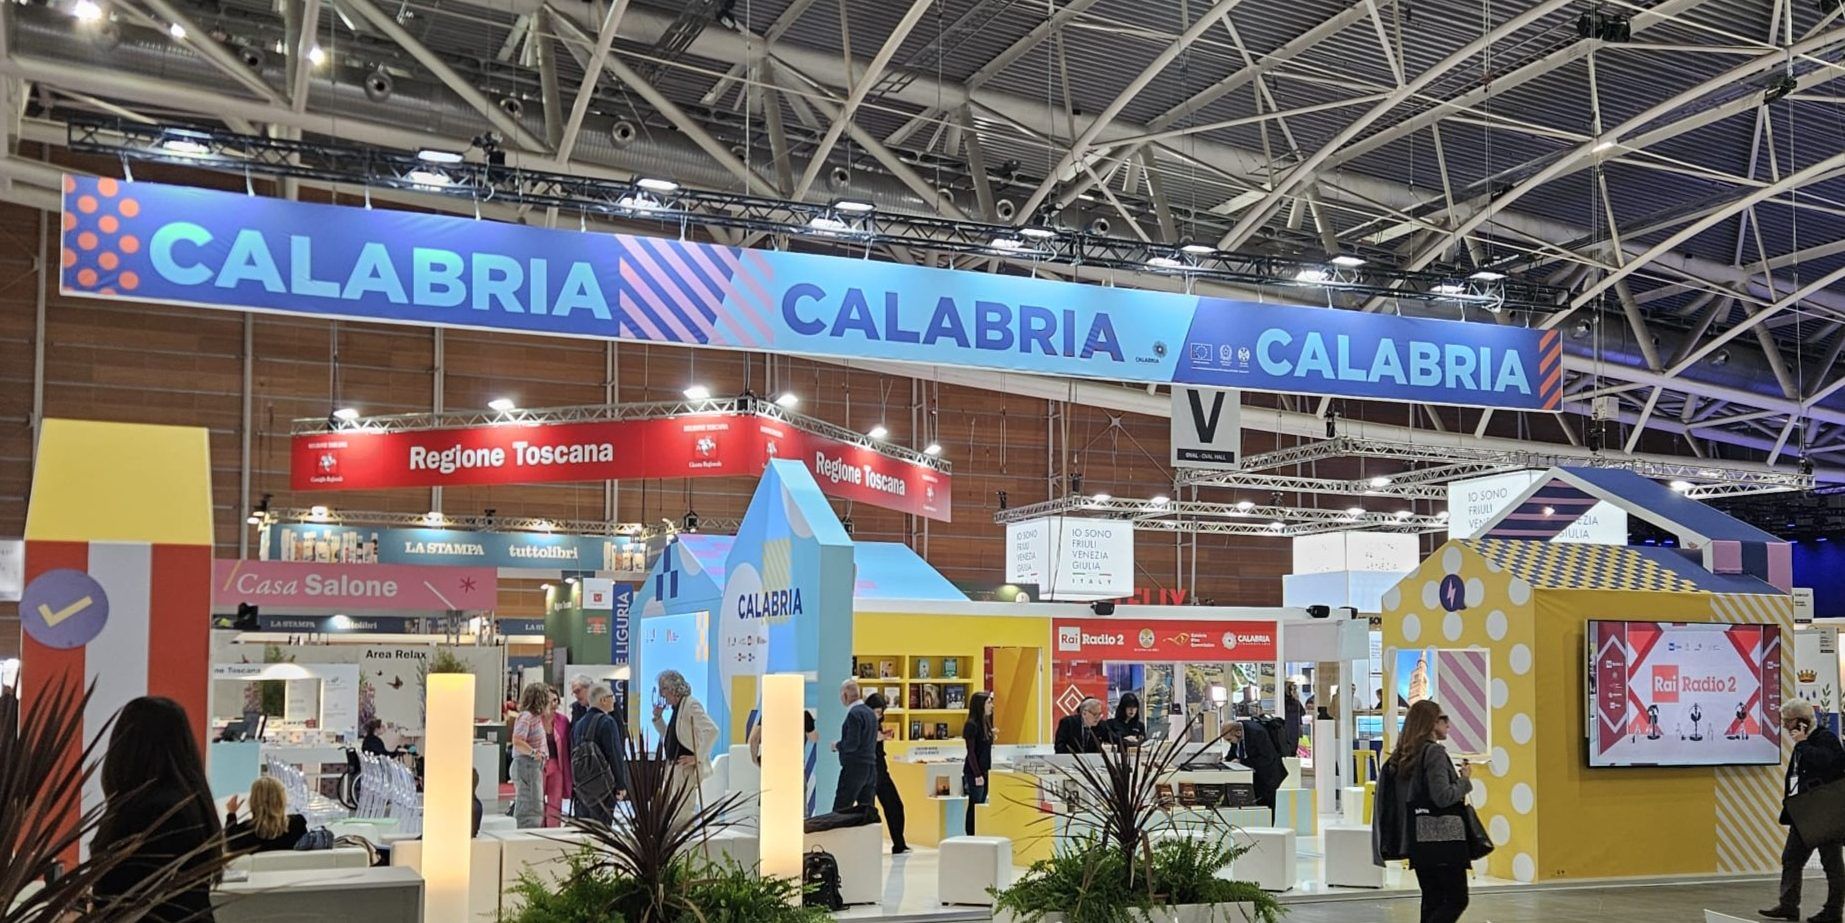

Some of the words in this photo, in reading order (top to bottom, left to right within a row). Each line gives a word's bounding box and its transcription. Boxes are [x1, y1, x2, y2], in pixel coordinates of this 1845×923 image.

[148, 221, 613, 320] CALABRIA
[781, 283, 1125, 363] CALABRIA
[1256, 328, 1532, 396] CALABRIA
[1187, 389, 1226, 444] V
[410, 444, 505, 474] Regione
[512, 441, 614, 466] Toscana
[815, 451, 861, 485] Regione
[863, 464, 906, 496] Toscana
[1467, 491, 1478, 502] IO
[1480, 487, 1508, 501] SONO
[1468, 503, 1493, 516] FRIULI
[1071, 528, 1083, 538] IO
[1084, 528, 1112, 539] SONO
[405, 542, 424, 554] LA
[427, 542, 485, 556] STAMPA
[508, 544, 579, 559] tuttolibri
[1071, 539, 1097, 549] FRIULI
[1071, 550, 1109, 560] VENEZIA
[1071, 561, 1101, 570] GIULIA
[236, 573, 298, 596] Casa
[304, 574, 398, 598] Salone
[737, 587, 803, 620] CALABRIA
[615, 591, 629, 655] LIGURIA
[1061, 633, 1079, 645] Rai
[1082, 633, 1116, 645] Radio
[1116, 634, 1125, 646] 2
[1237, 634, 1271, 643] CALABRIA
[365, 650, 392, 660] Area
[395, 650, 427, 660] Relax
[1654, 674, 1677, 693] Rai
[1681, 675, 1726, 693] Radio
[1727, 676, 1737, 693] 2
